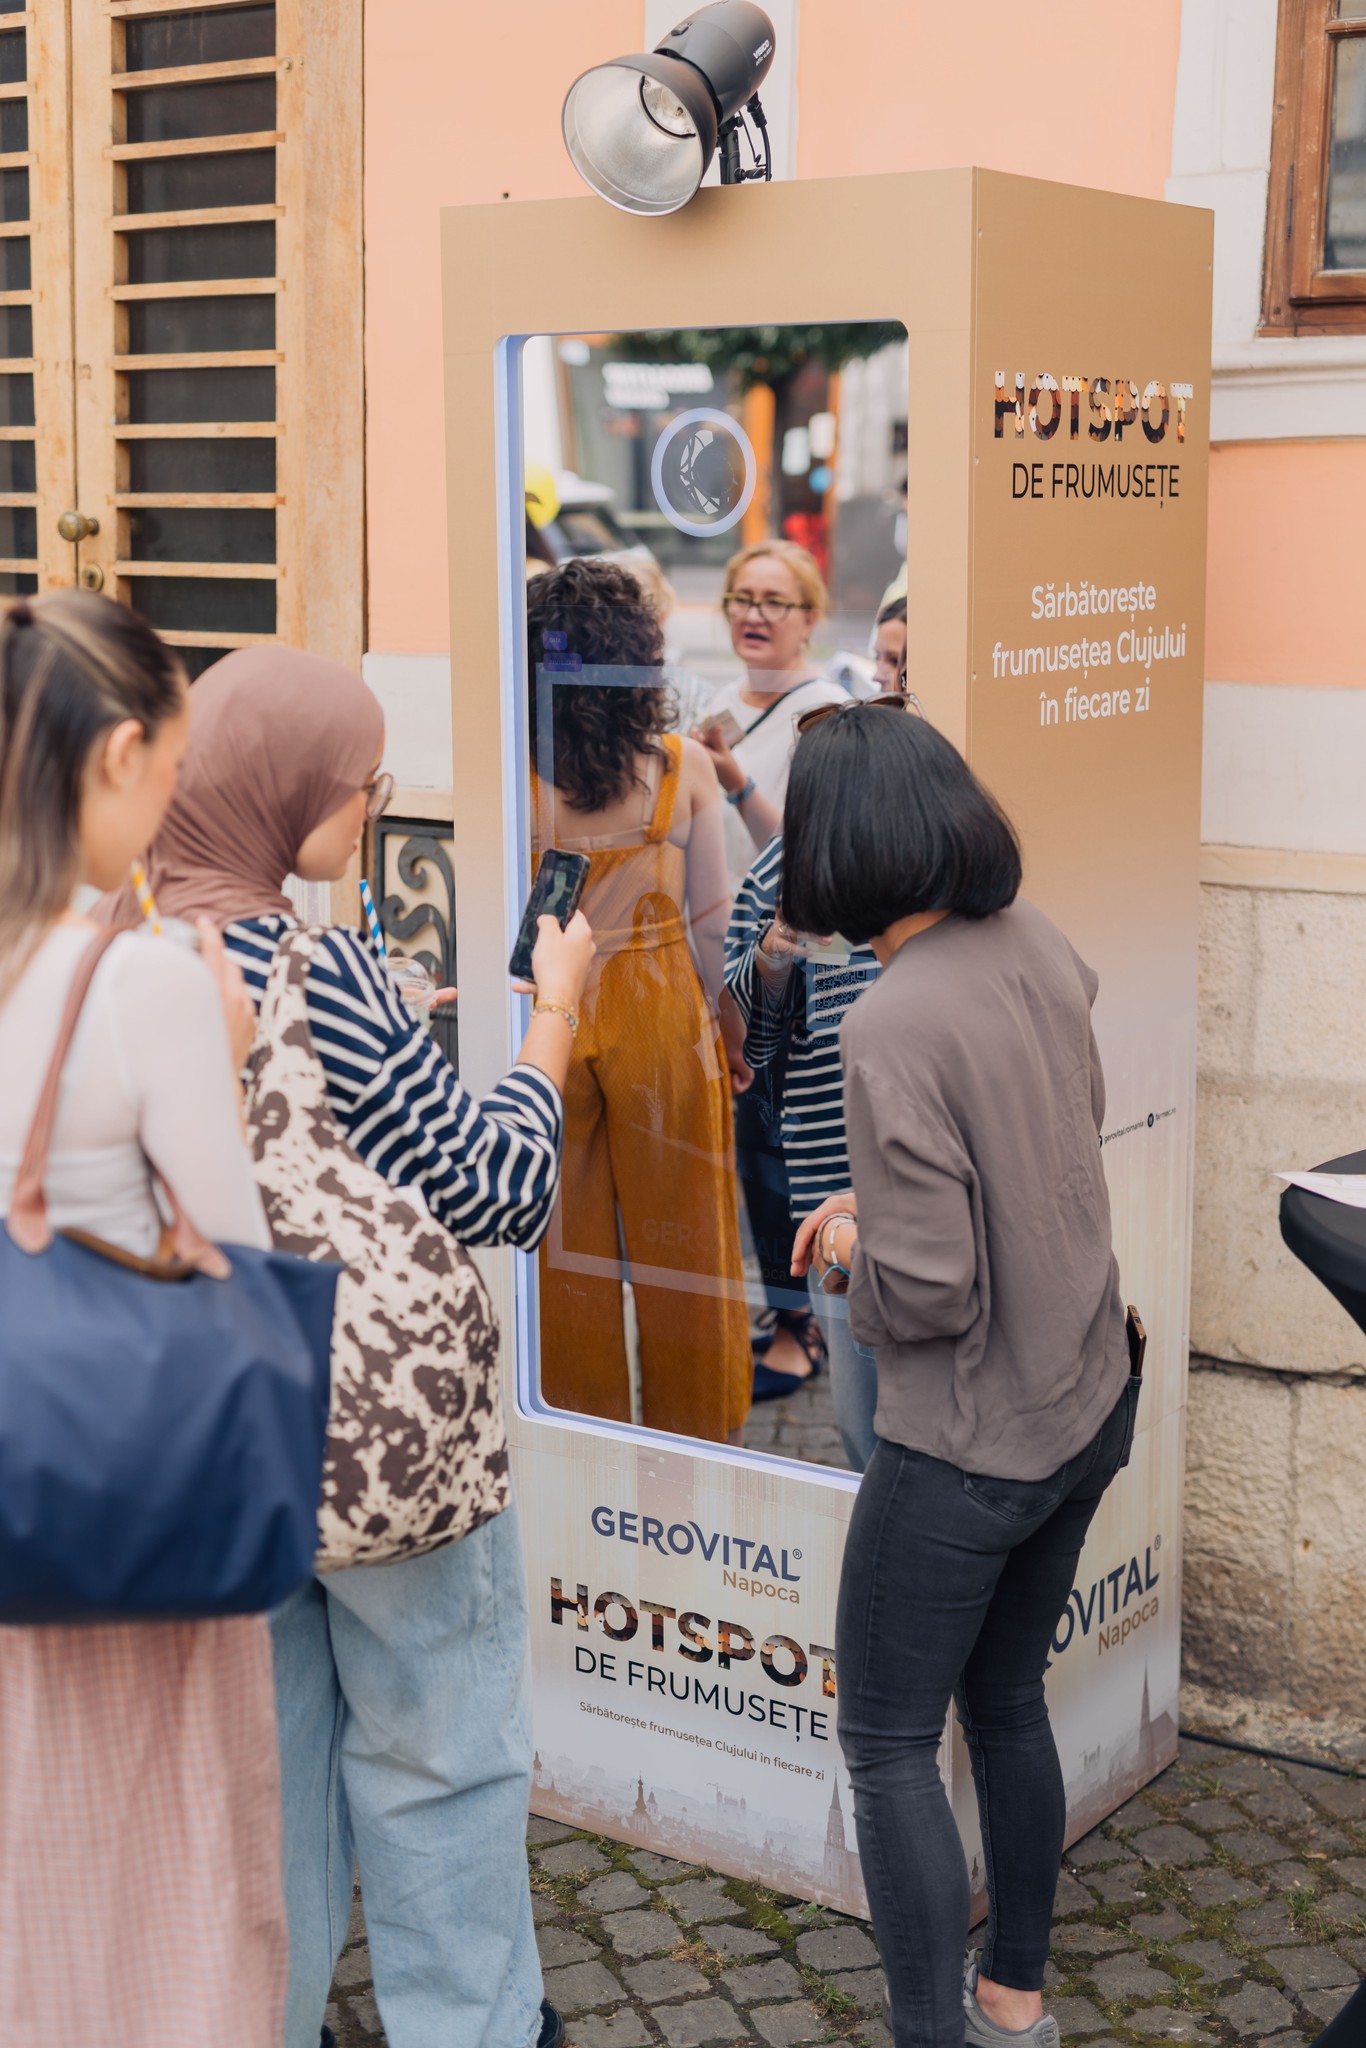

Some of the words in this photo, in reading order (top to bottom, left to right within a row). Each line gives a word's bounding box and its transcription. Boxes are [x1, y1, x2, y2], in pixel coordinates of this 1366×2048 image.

[994, 371, 1194, 444] HOTSPOT
[1012, 463, 1044, 499] DE
[1052, 463, 1180, 509] FRUMUSEȚE
[1031, 581, 1157, 622] Sărbătorește
[992, 637, 1112, 679] frumusețea
[1116, 622, 1187, 669] Clujului
[1039, 691, 1059, 726] în
[1064, 686, 1131, 722] fiecare
[1135, 676, 1150, 712] zi
[723, 1569, 801, 1604] Napoca
[1046, 1534, 1162, 1669] OVITAL®
[550, 1576, 836, 1699] HOTSPOT
[1098, 1596, 1160, 1656] Napoca
[575, 1646, 617, 1682] DE
[628, 1660, 829, 1742] FRUMUSEȚE
[579, 1701, 647, 1729] Sărbătorește
[649, 1721, 712, 1748] frumusețea
[715, 1740, 757, 1760] Clujului
[760, 1752, 771, 1765] în
[773, 1757, 813, 1777] fiecare
[816, 1770, 825, 1781] zi
